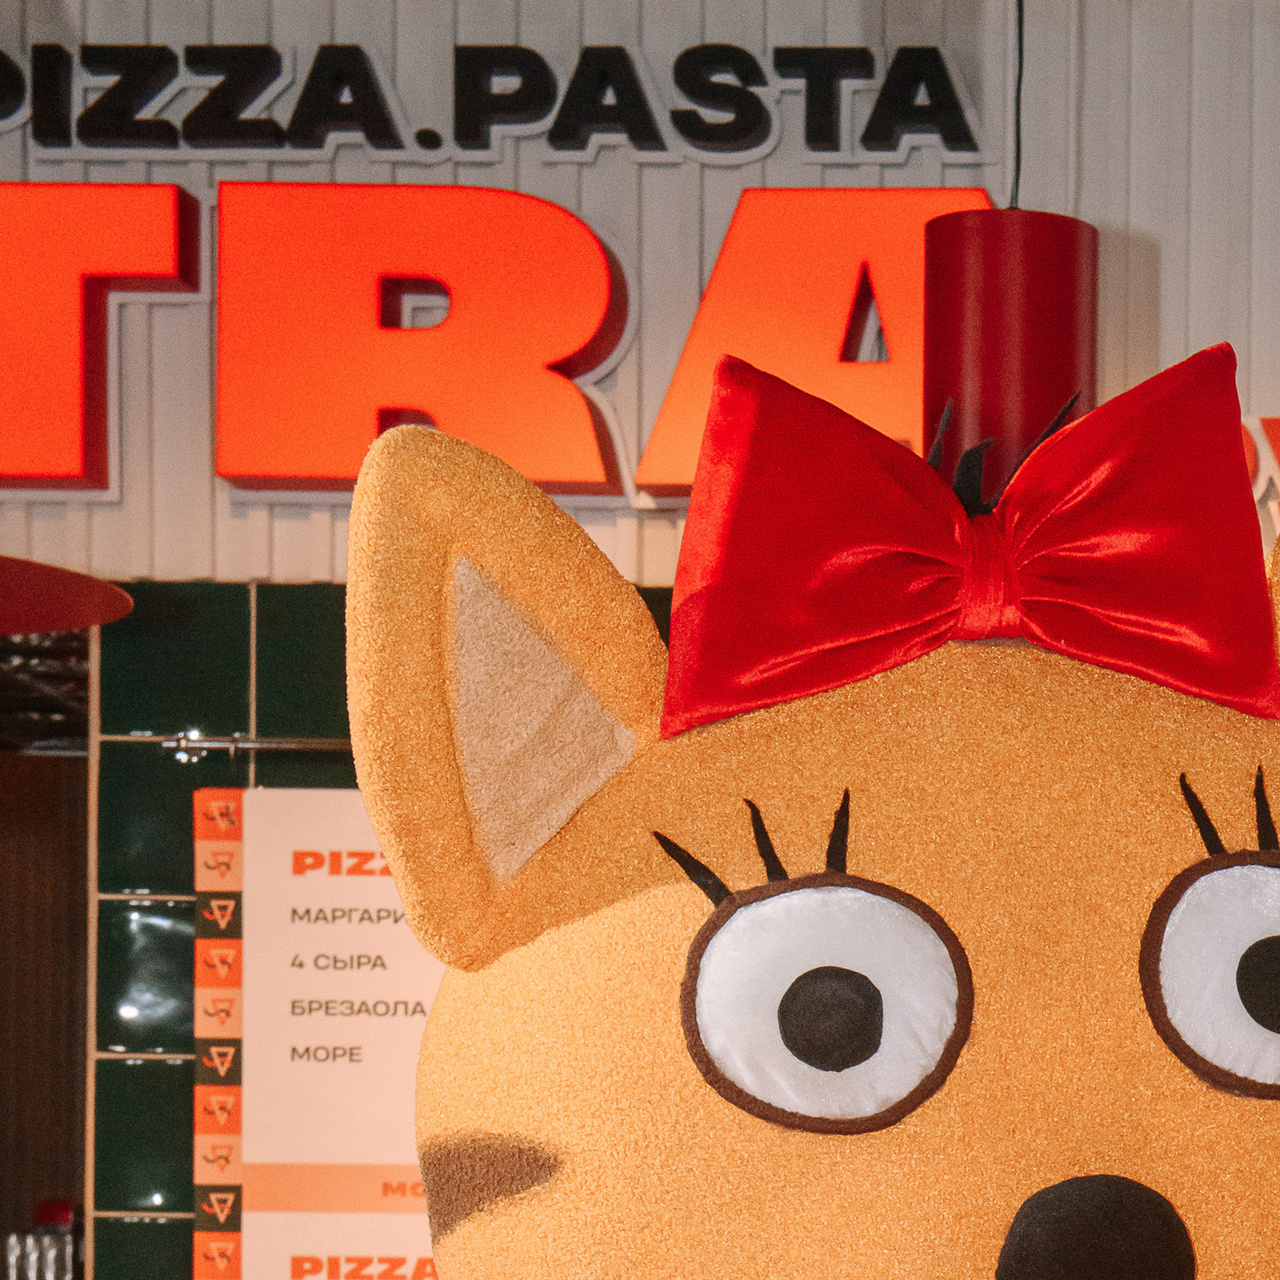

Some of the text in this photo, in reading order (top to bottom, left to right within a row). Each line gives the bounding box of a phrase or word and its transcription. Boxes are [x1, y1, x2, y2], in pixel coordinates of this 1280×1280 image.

[0, 43, 979, 152] IZZA.PASTA
[290, 954, 388, 970] 4 СЫРА
[291, 999, 428, 1017] БРЕЗАОЛА
[290, 1046, 363, 1063] МОРЕ
